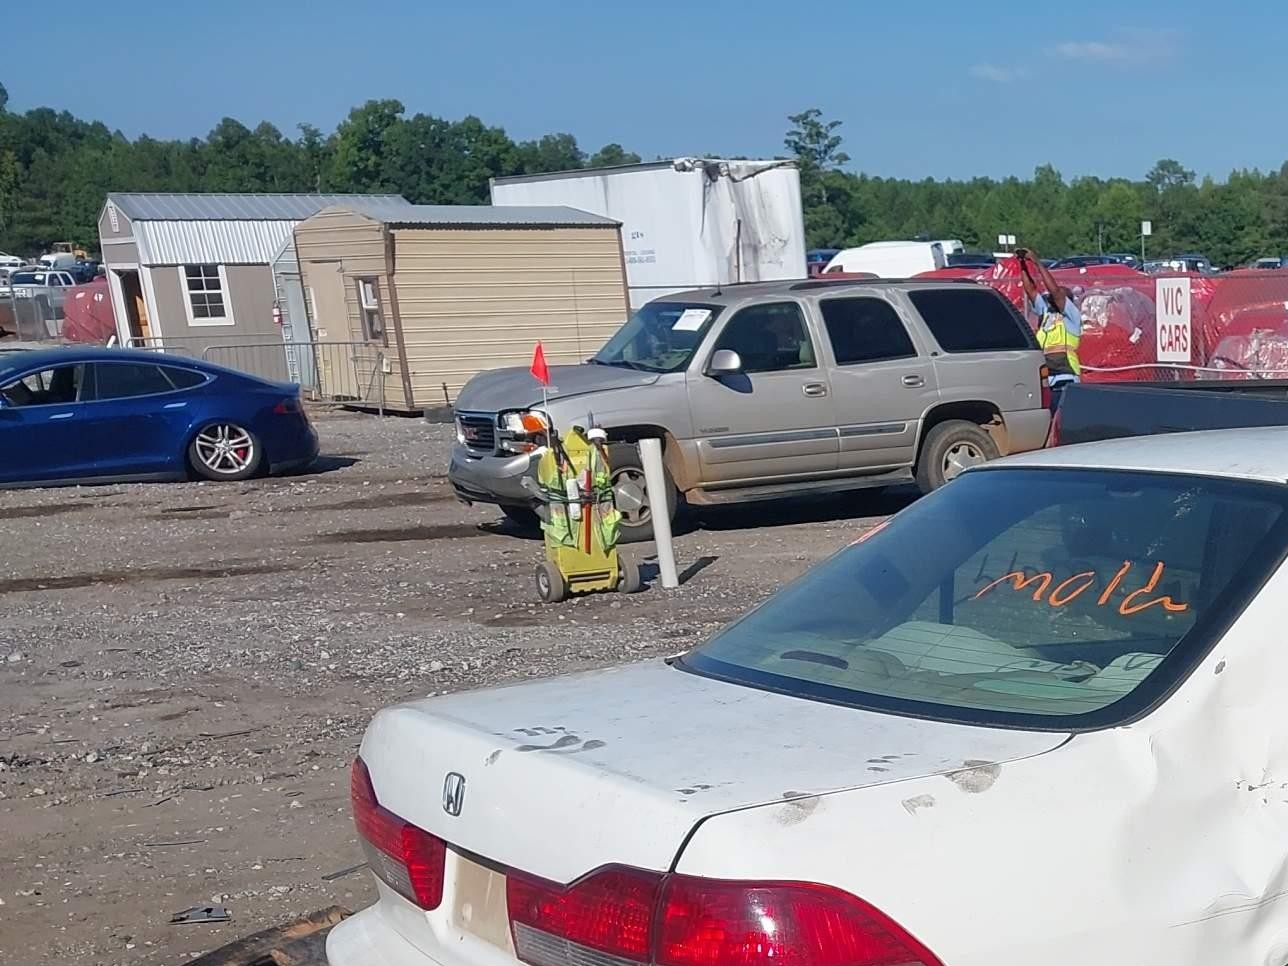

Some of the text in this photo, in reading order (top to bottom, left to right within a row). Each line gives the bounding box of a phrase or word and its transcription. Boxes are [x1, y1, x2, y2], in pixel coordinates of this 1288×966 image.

[1162, 287, 1183, 315] VIC
[1160, 324, 1188, 352] CARS
[969, 560, 1189, 615] mold
